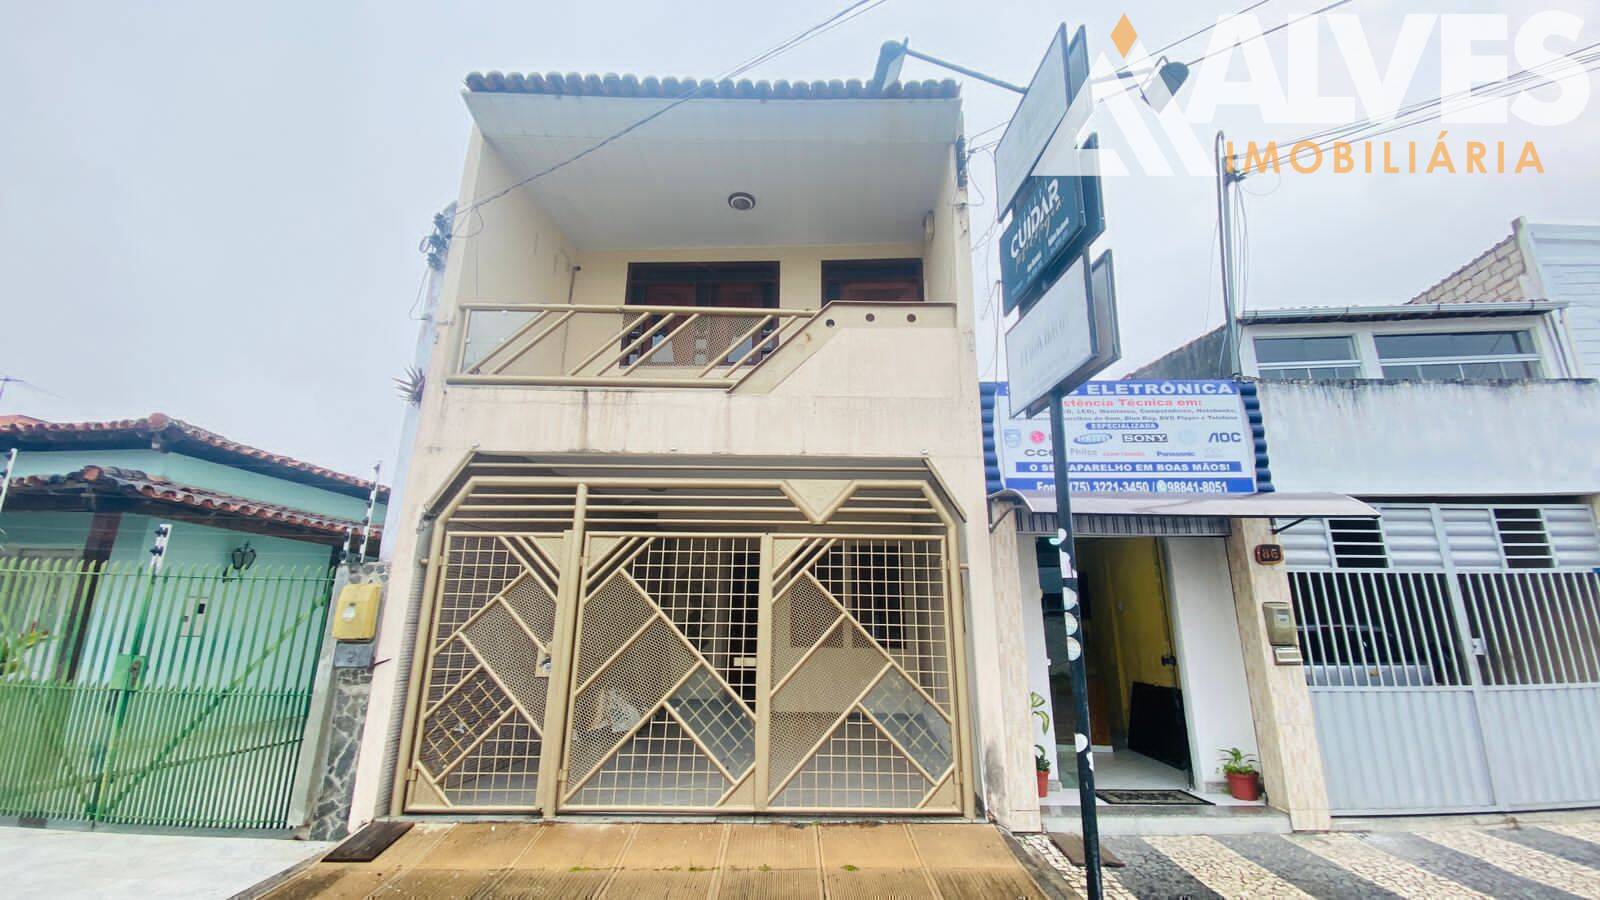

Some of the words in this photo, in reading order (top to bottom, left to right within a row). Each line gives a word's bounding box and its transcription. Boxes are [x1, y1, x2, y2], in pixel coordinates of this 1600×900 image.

[1010, 178, 1058, 259] CUIDAR
[1087, 382, 1233, 394] ELETRÔNICA
[1119, 397, 1173, 407] Técnica
[1176, 398, 1202, 407] em:
[1123, 434, 1168, 442] SONY
[1208, 432, 1241, 442] AOC
[1029, 463, 1038, 471] O
[1041, 463, 1055, 471] SE
[1068, 463, 1133, 471] APARELHO
[1135, 463, 1153, 471] EM
[1156, 463, 1189, 471] BOAS
[1192, 463, 1231, 471] MÃOS!
[1069, 481, 1090, 492] (75)
[1093, 481, 1149, 492] 3221-3450
[1167, 480, 1228, 492] 98841-8051
